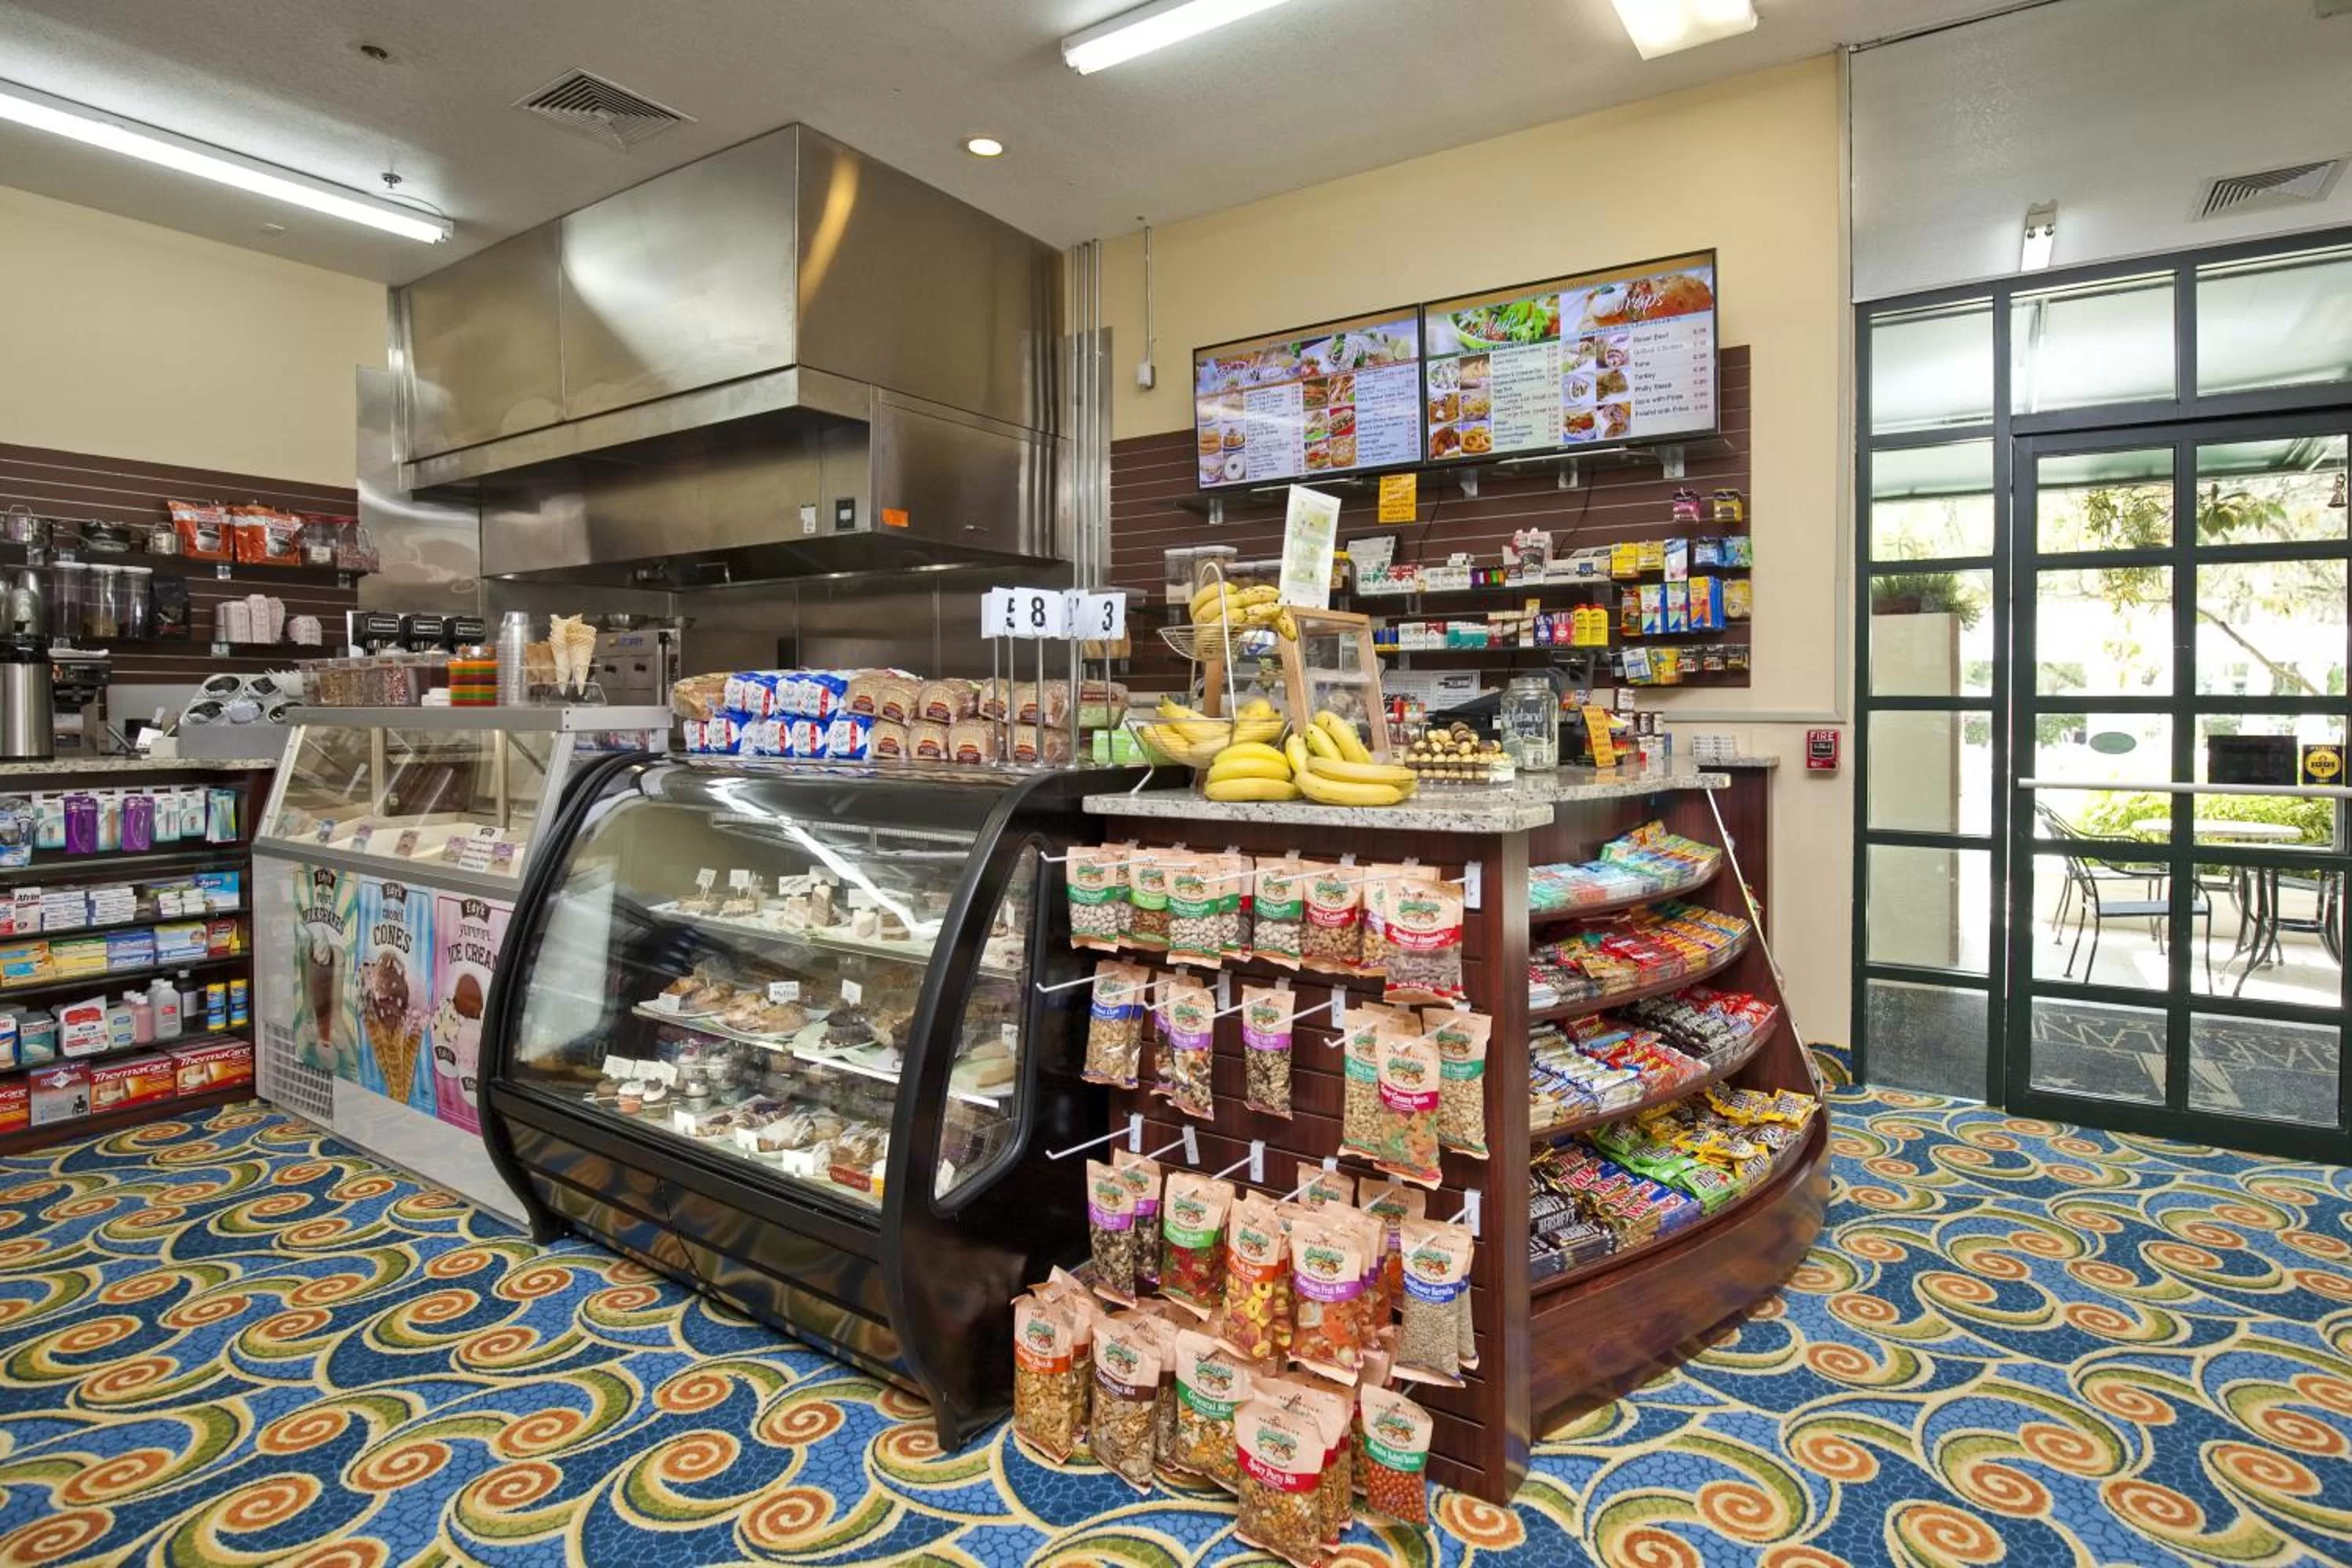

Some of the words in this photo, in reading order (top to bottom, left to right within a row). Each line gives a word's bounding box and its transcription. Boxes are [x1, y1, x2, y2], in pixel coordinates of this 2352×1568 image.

[1031, 597, 1046, 627] 8
[1102, 601, 1113, 630] 3
[1811, 731, 1834, 741] FIRE
[17, 892, 40, 902] Afrin
[373, 924, 412, 954] CONES
[448, 942, 463, 965] ICE
[181, 1046, 251, 1066] ThermaCare
[94, 1061, 171, 1082] ThermaCare
[1247, 1457, 1265, 1477] Spicy
[1265, 1467, 1284, 1486] Party
[1284, 1475, 1298, 1486] Mix
